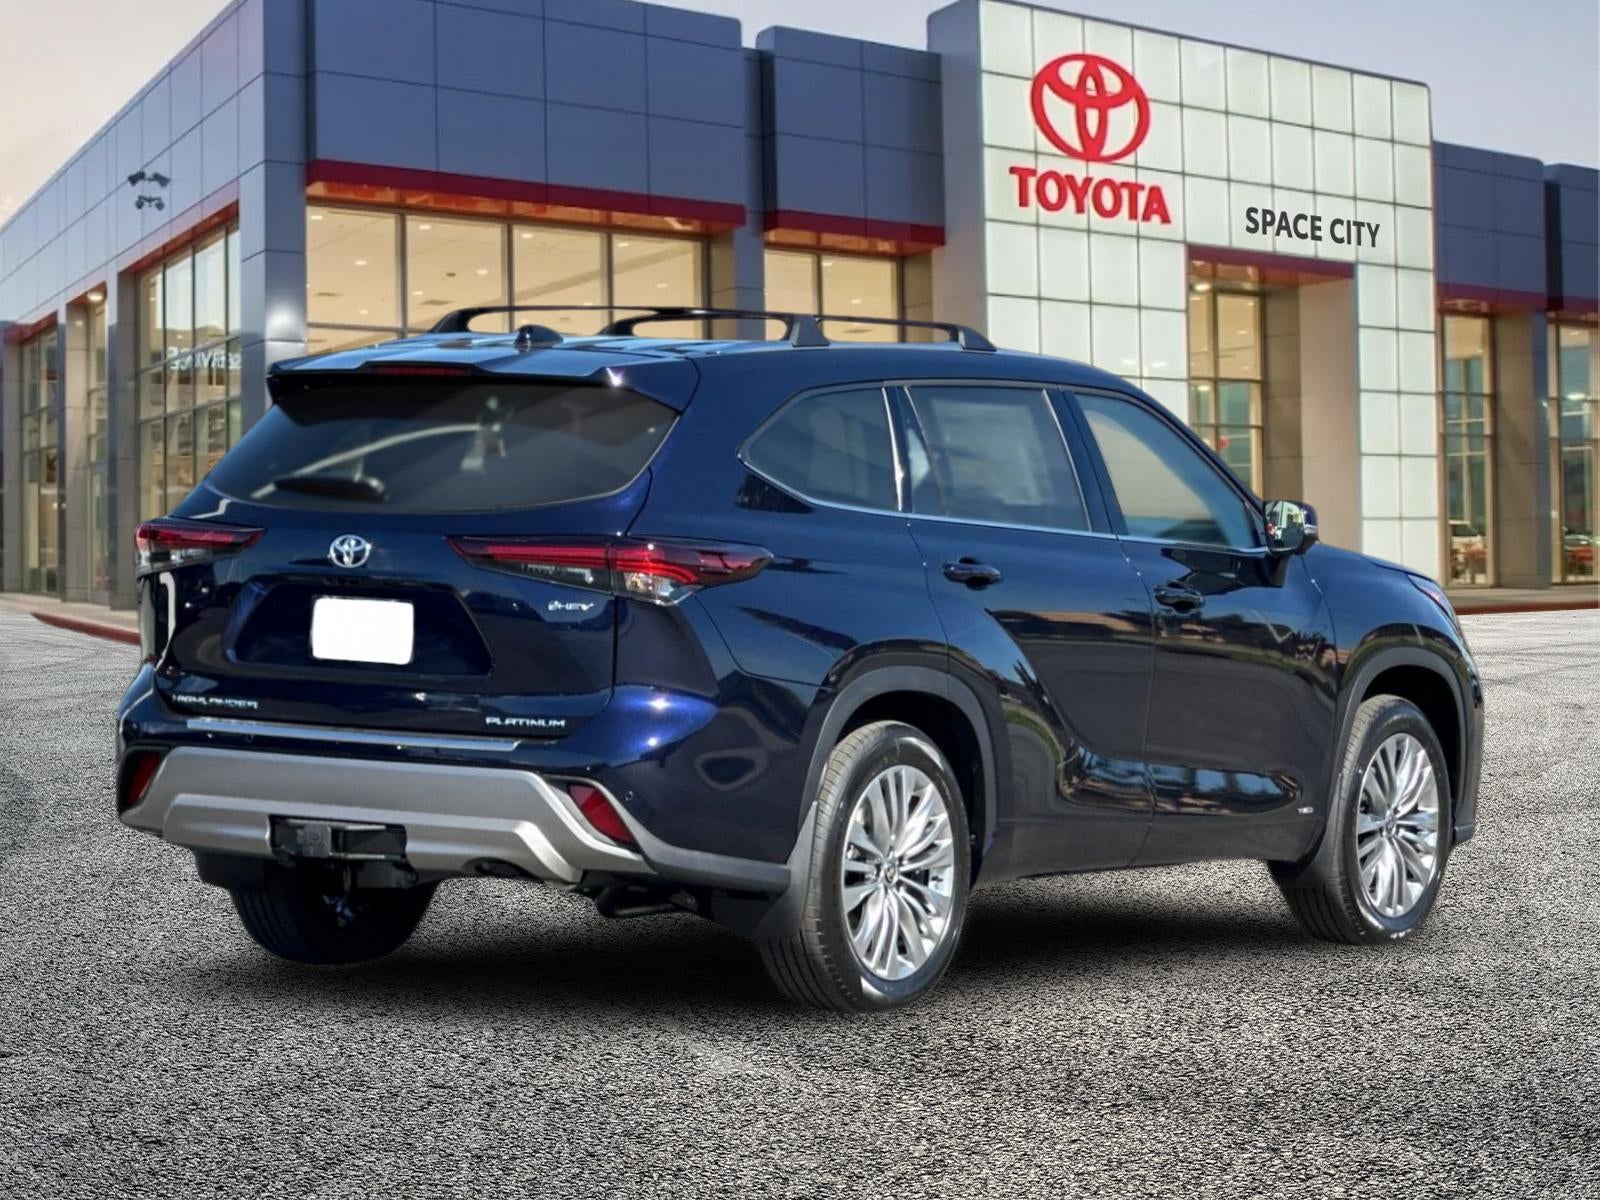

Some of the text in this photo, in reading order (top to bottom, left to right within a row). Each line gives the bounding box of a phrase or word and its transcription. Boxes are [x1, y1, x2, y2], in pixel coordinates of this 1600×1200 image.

[1009, 166, 1171, 225] TOYOTA
[1245, 206, 1381, 248] SPACE CITY
[485, 716, 566, 729] PLATINUM
